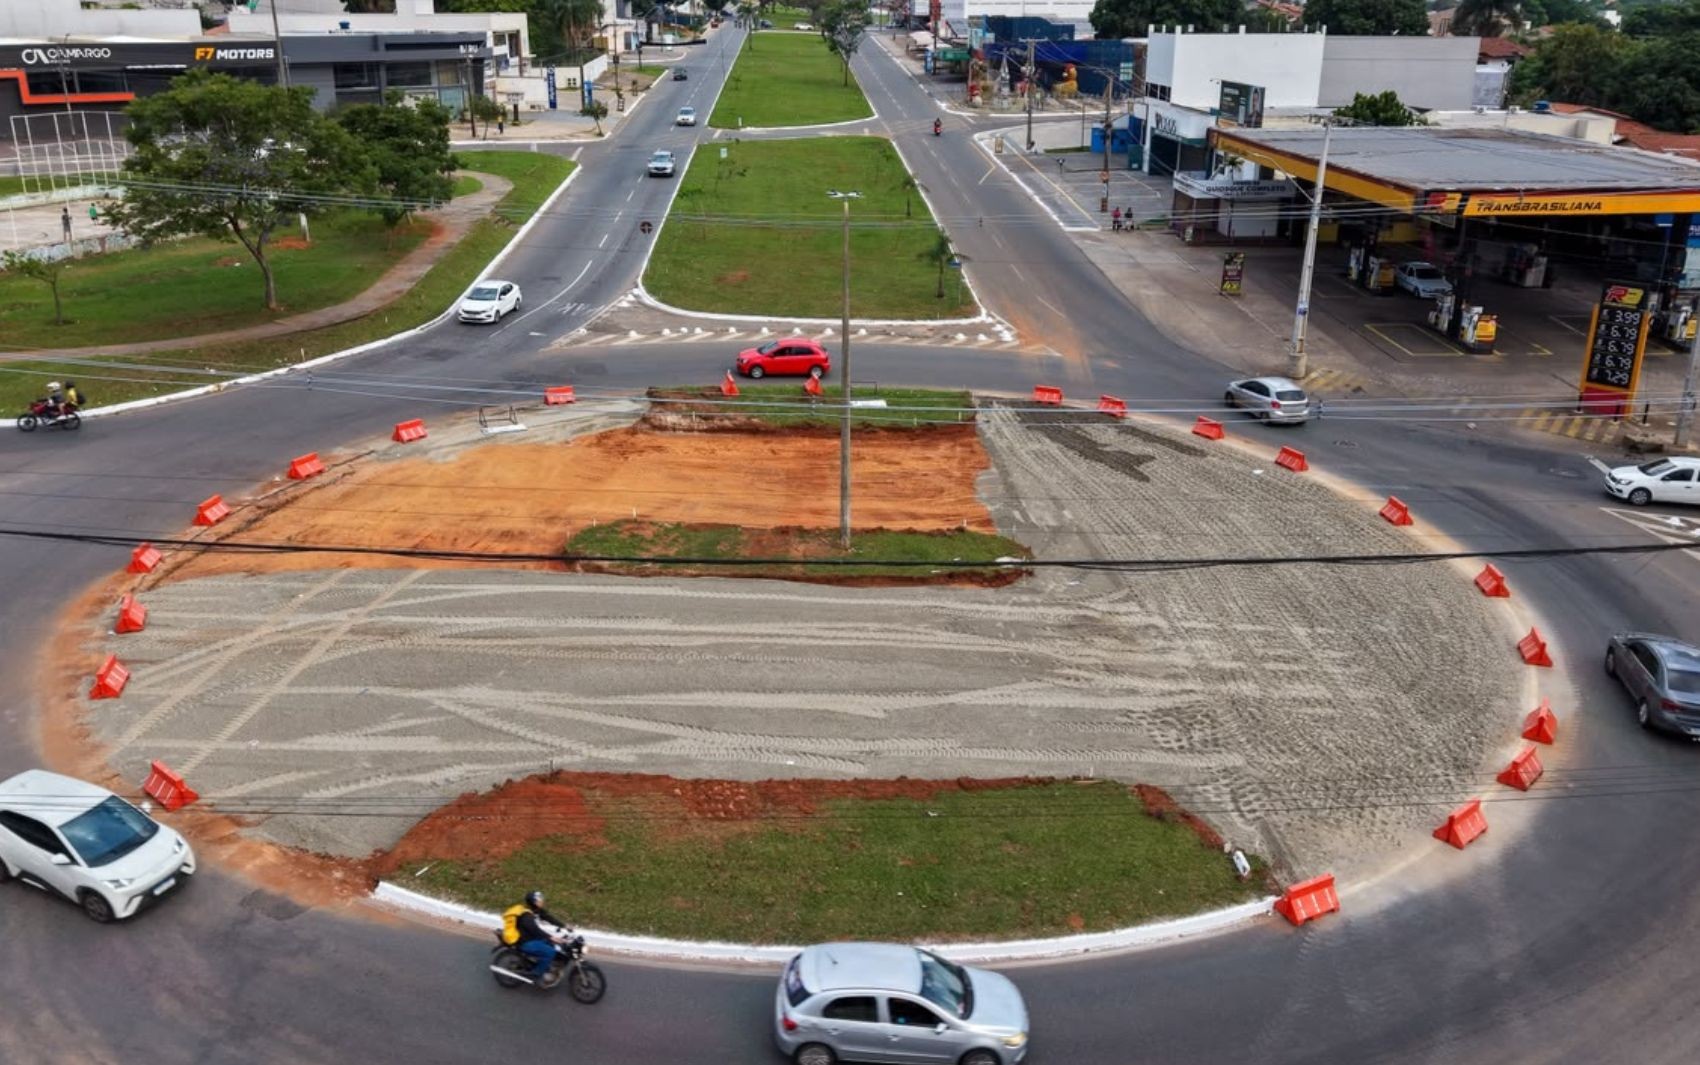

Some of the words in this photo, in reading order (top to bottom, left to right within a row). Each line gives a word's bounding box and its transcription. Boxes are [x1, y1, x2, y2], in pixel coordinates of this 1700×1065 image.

[47, 48, 112, 58] CAMARGO
[195, 47, 215, 60] F7
[216, 48, 275, 60] MOTORS
[1476, 202, 1602, 212] TRANSBRASILIANA
[1610, 325, 1637, 340] 6.79
[1607, 340, 1635, 355] 6.79
[1604, 355, 1632, 370] 6.79
